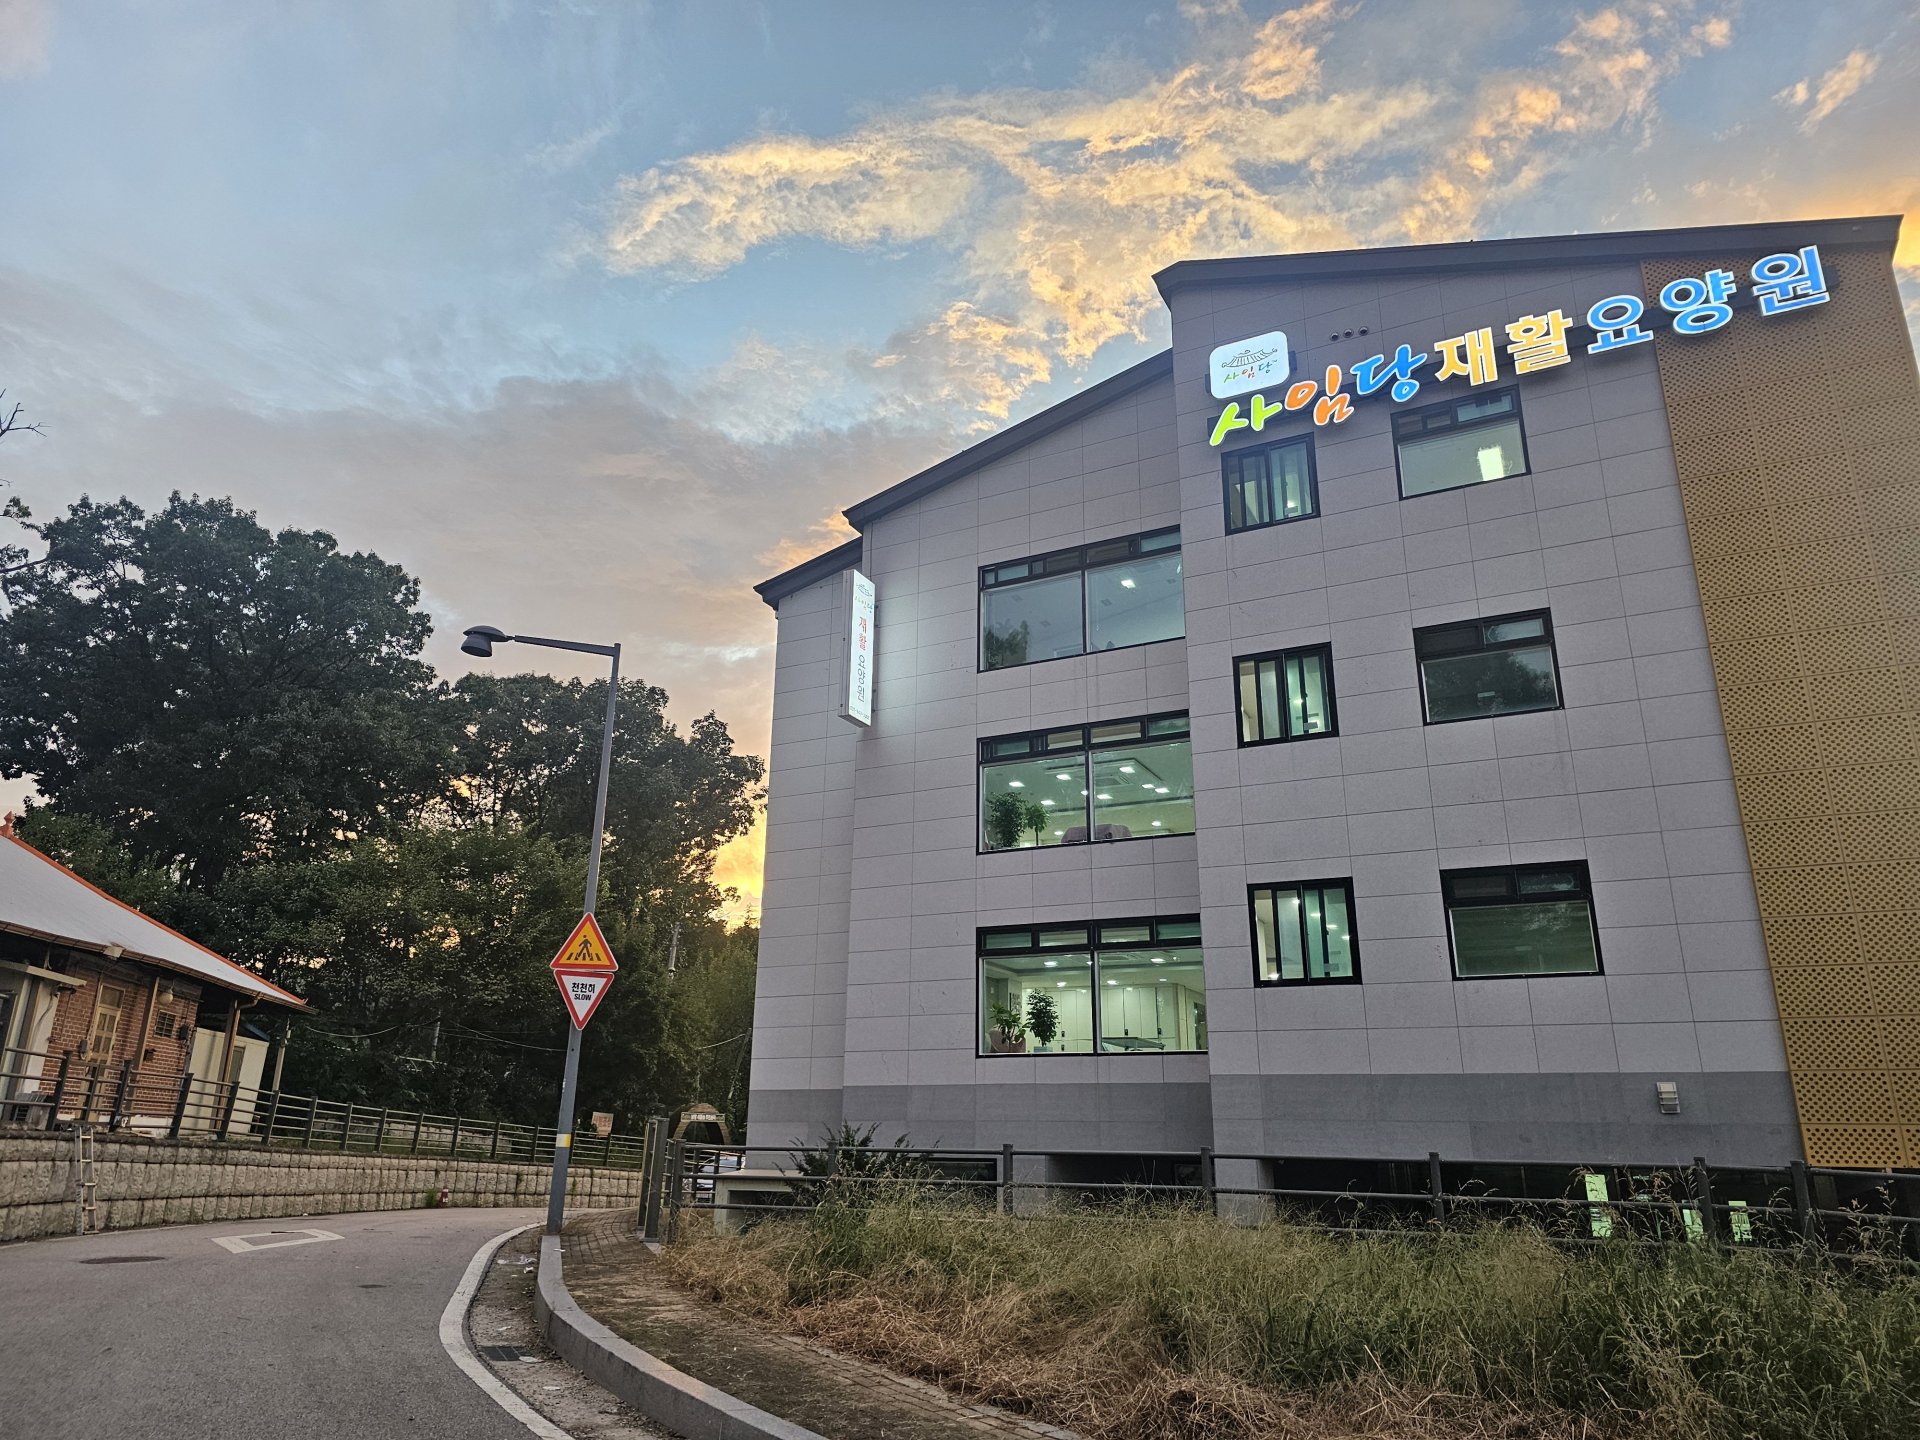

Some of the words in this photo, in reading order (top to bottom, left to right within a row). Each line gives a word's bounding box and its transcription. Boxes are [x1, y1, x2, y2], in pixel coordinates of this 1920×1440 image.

[1223, 361, 1273, 383] 사임당
[571, 982, 596, 994] 천천히
[573, 993, 592, 1001] SLOW
